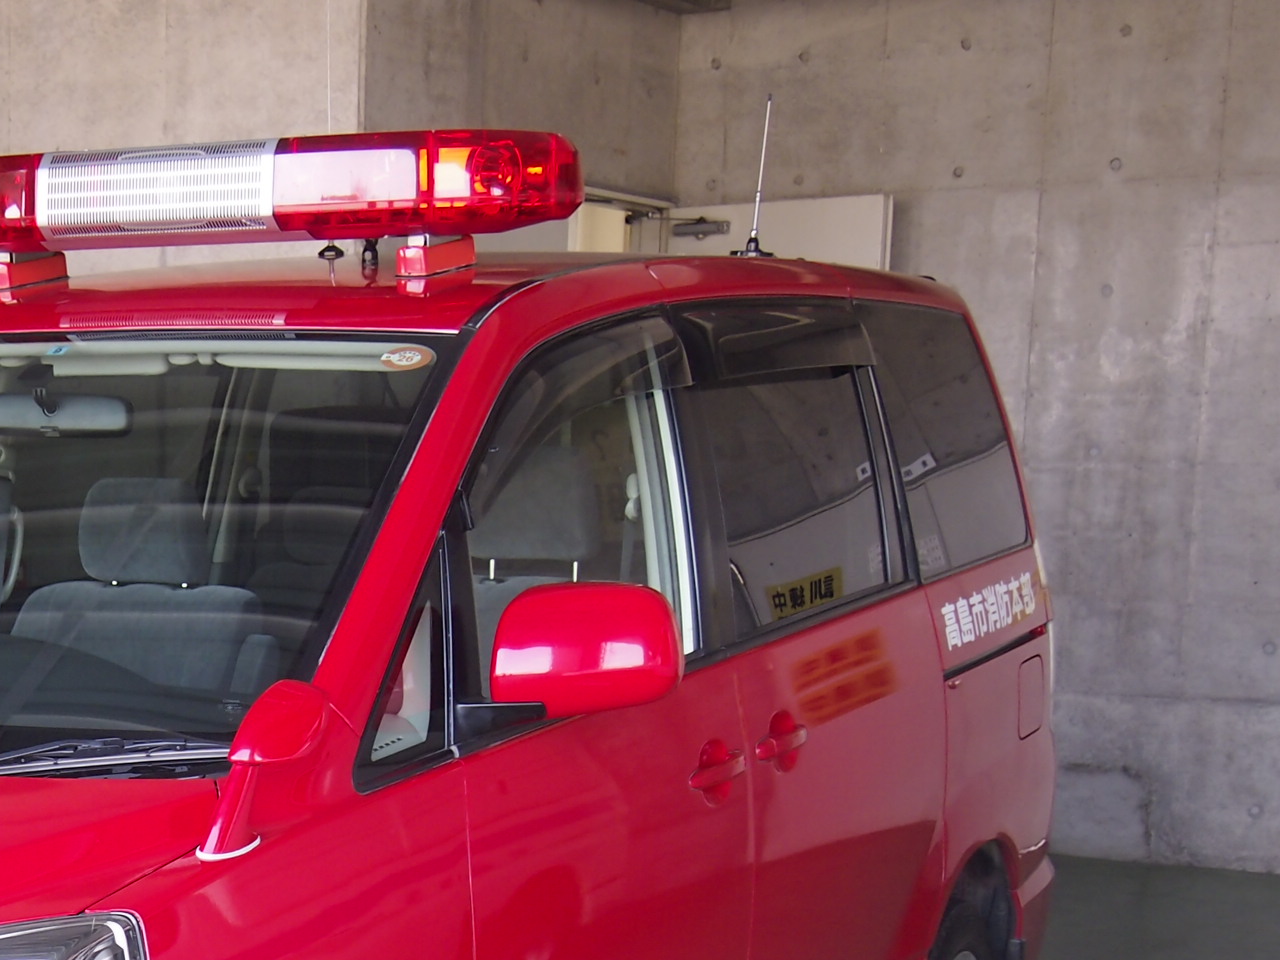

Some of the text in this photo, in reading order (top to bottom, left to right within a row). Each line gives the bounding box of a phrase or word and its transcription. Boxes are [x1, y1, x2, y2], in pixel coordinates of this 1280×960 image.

[941, 572, 1036, 651] 高島市消防本部
